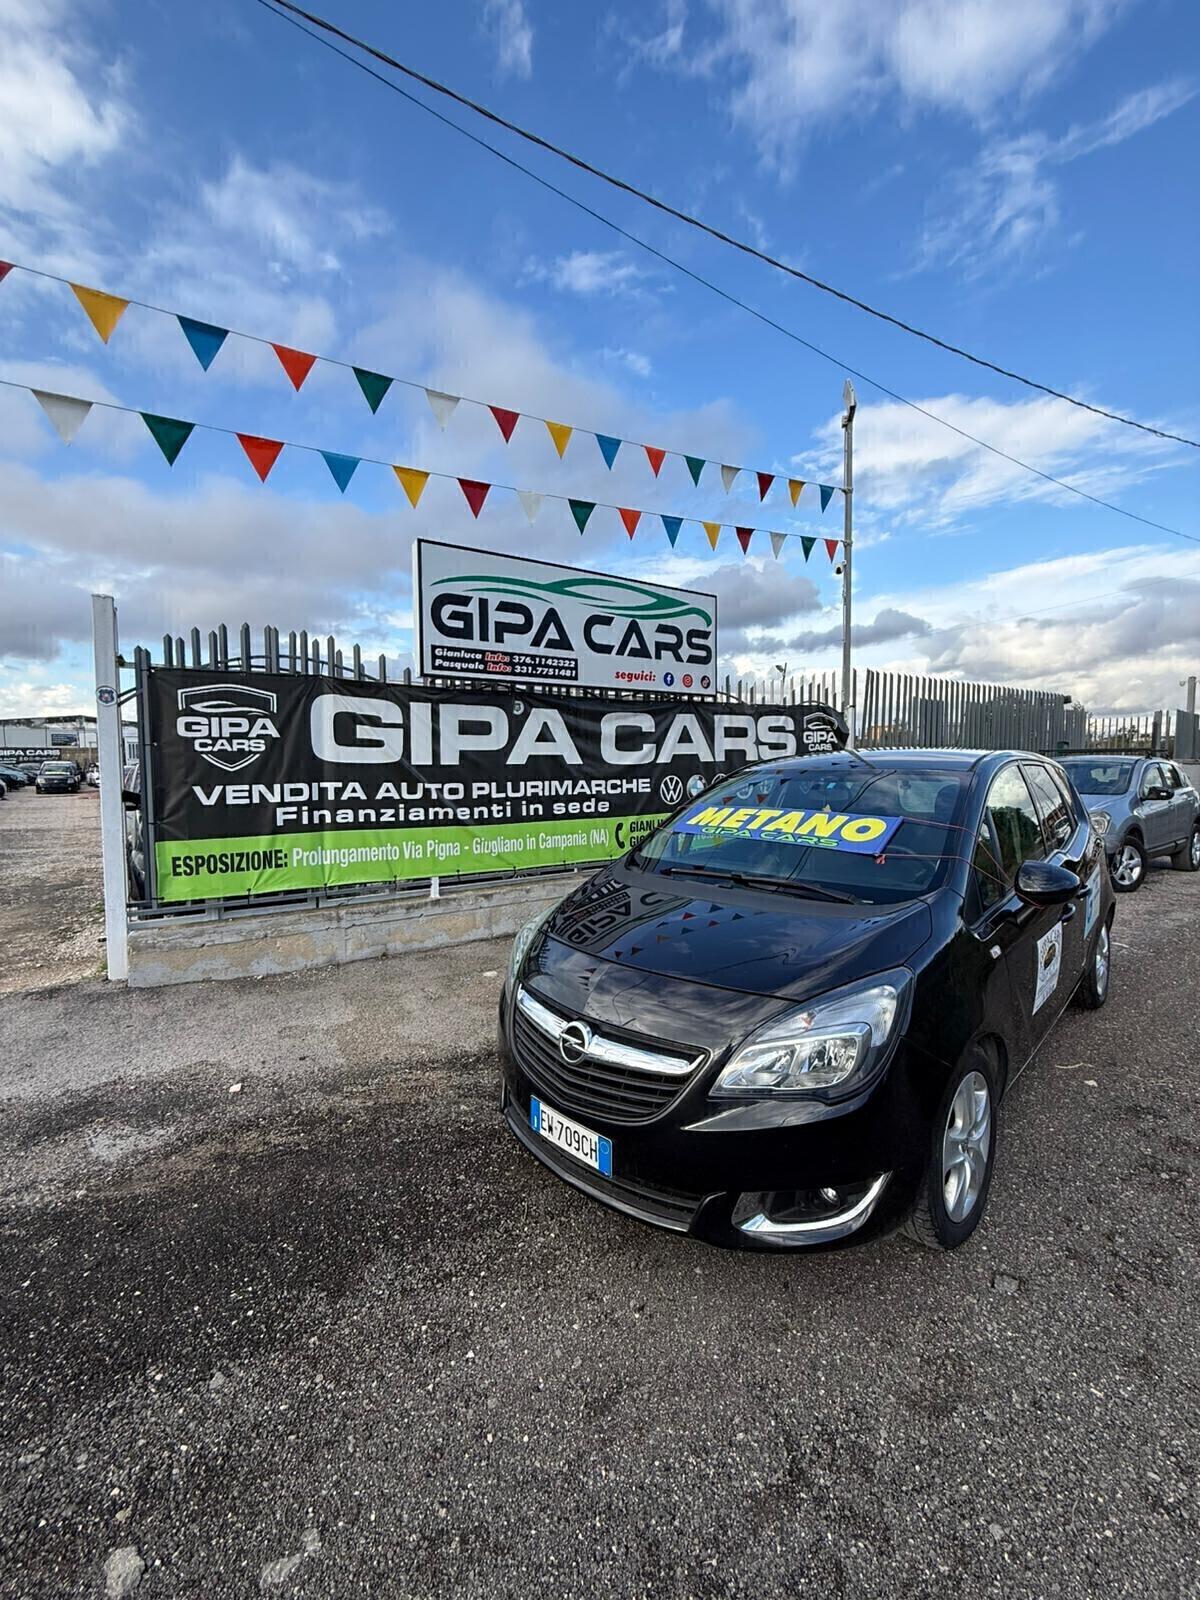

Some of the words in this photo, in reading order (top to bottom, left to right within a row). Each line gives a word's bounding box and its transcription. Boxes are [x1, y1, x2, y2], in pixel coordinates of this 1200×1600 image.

[431, 592, 575, 651] GIPA
[583, 614, 712, 665] CARS
[435, 648, 482, 659] Gianluca
[485, 652, 510, 662] Info:
[513, 655, 575, 667] 376.1142322
[435, 659, 484, 670] Pasquale
[487, 663, 512, 673] Info:
[514, 666, 576, 677] 331.7751481
[615, 670, 656, 682] seguici:
[176, 716, 280, 738] GIPA
[310, 694, 582, 766] GIPA
[600, 712, 796, 765] CARS
[803, 731, 838, 743] GIPA
[194, 738, 266, 752] CARS
[808, 743, 833, 751] CARS
[192, 781, 367, 806] VENDITA
[375, 782, 464, 800] AUTO
[471, 778, 651, 799] PLURIMARCHE
[276, 802, 511, 826] Finanziamenti
[522, 801, 543, 816] in
[553, 798, 610, 814] sede
[686, 807, 887, 842] METANO
[702, 826, 752, 838] GIPA
[760, 832, 840, 847] CARS
[171, 849, 288, 876] ESPOSIZIONE:
[292, 843, 399, 868] Prolungamento
[402, 840, 423, 859] Via
[427, 840, 460, 861] Pigna
[473, 837, 524, 856] Giugliano
[526, 834, 536, 849] in
[539, 830, 587, 850] Campania
[589, 828, 609, 847] (NA)
